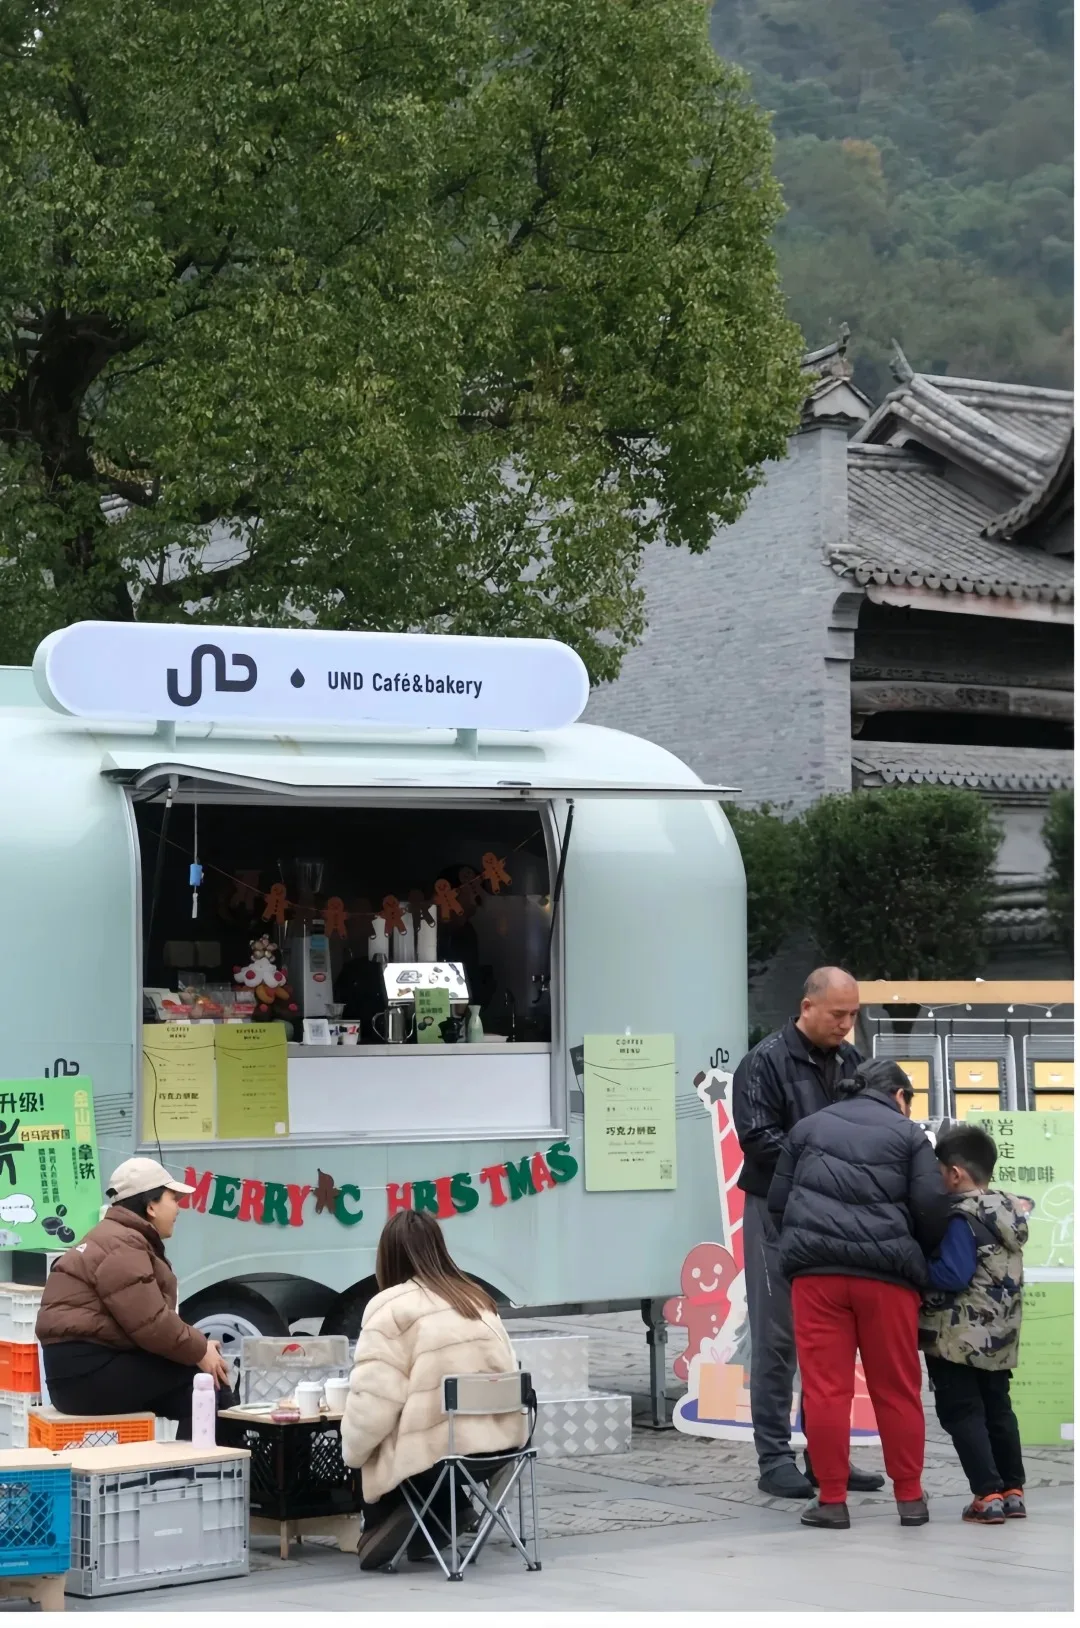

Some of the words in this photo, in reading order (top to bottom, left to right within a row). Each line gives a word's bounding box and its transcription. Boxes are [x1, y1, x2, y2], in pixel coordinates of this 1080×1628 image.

[328, 671, 363, 691] UND
[372, 672, 483, 699] Café&bakery
[605, 1126, 657, 1136] 巧克力拼配
[989, 1165, 1055, 1183] 碗咖啡
[179, 1166, 313, 1227] MERRY
